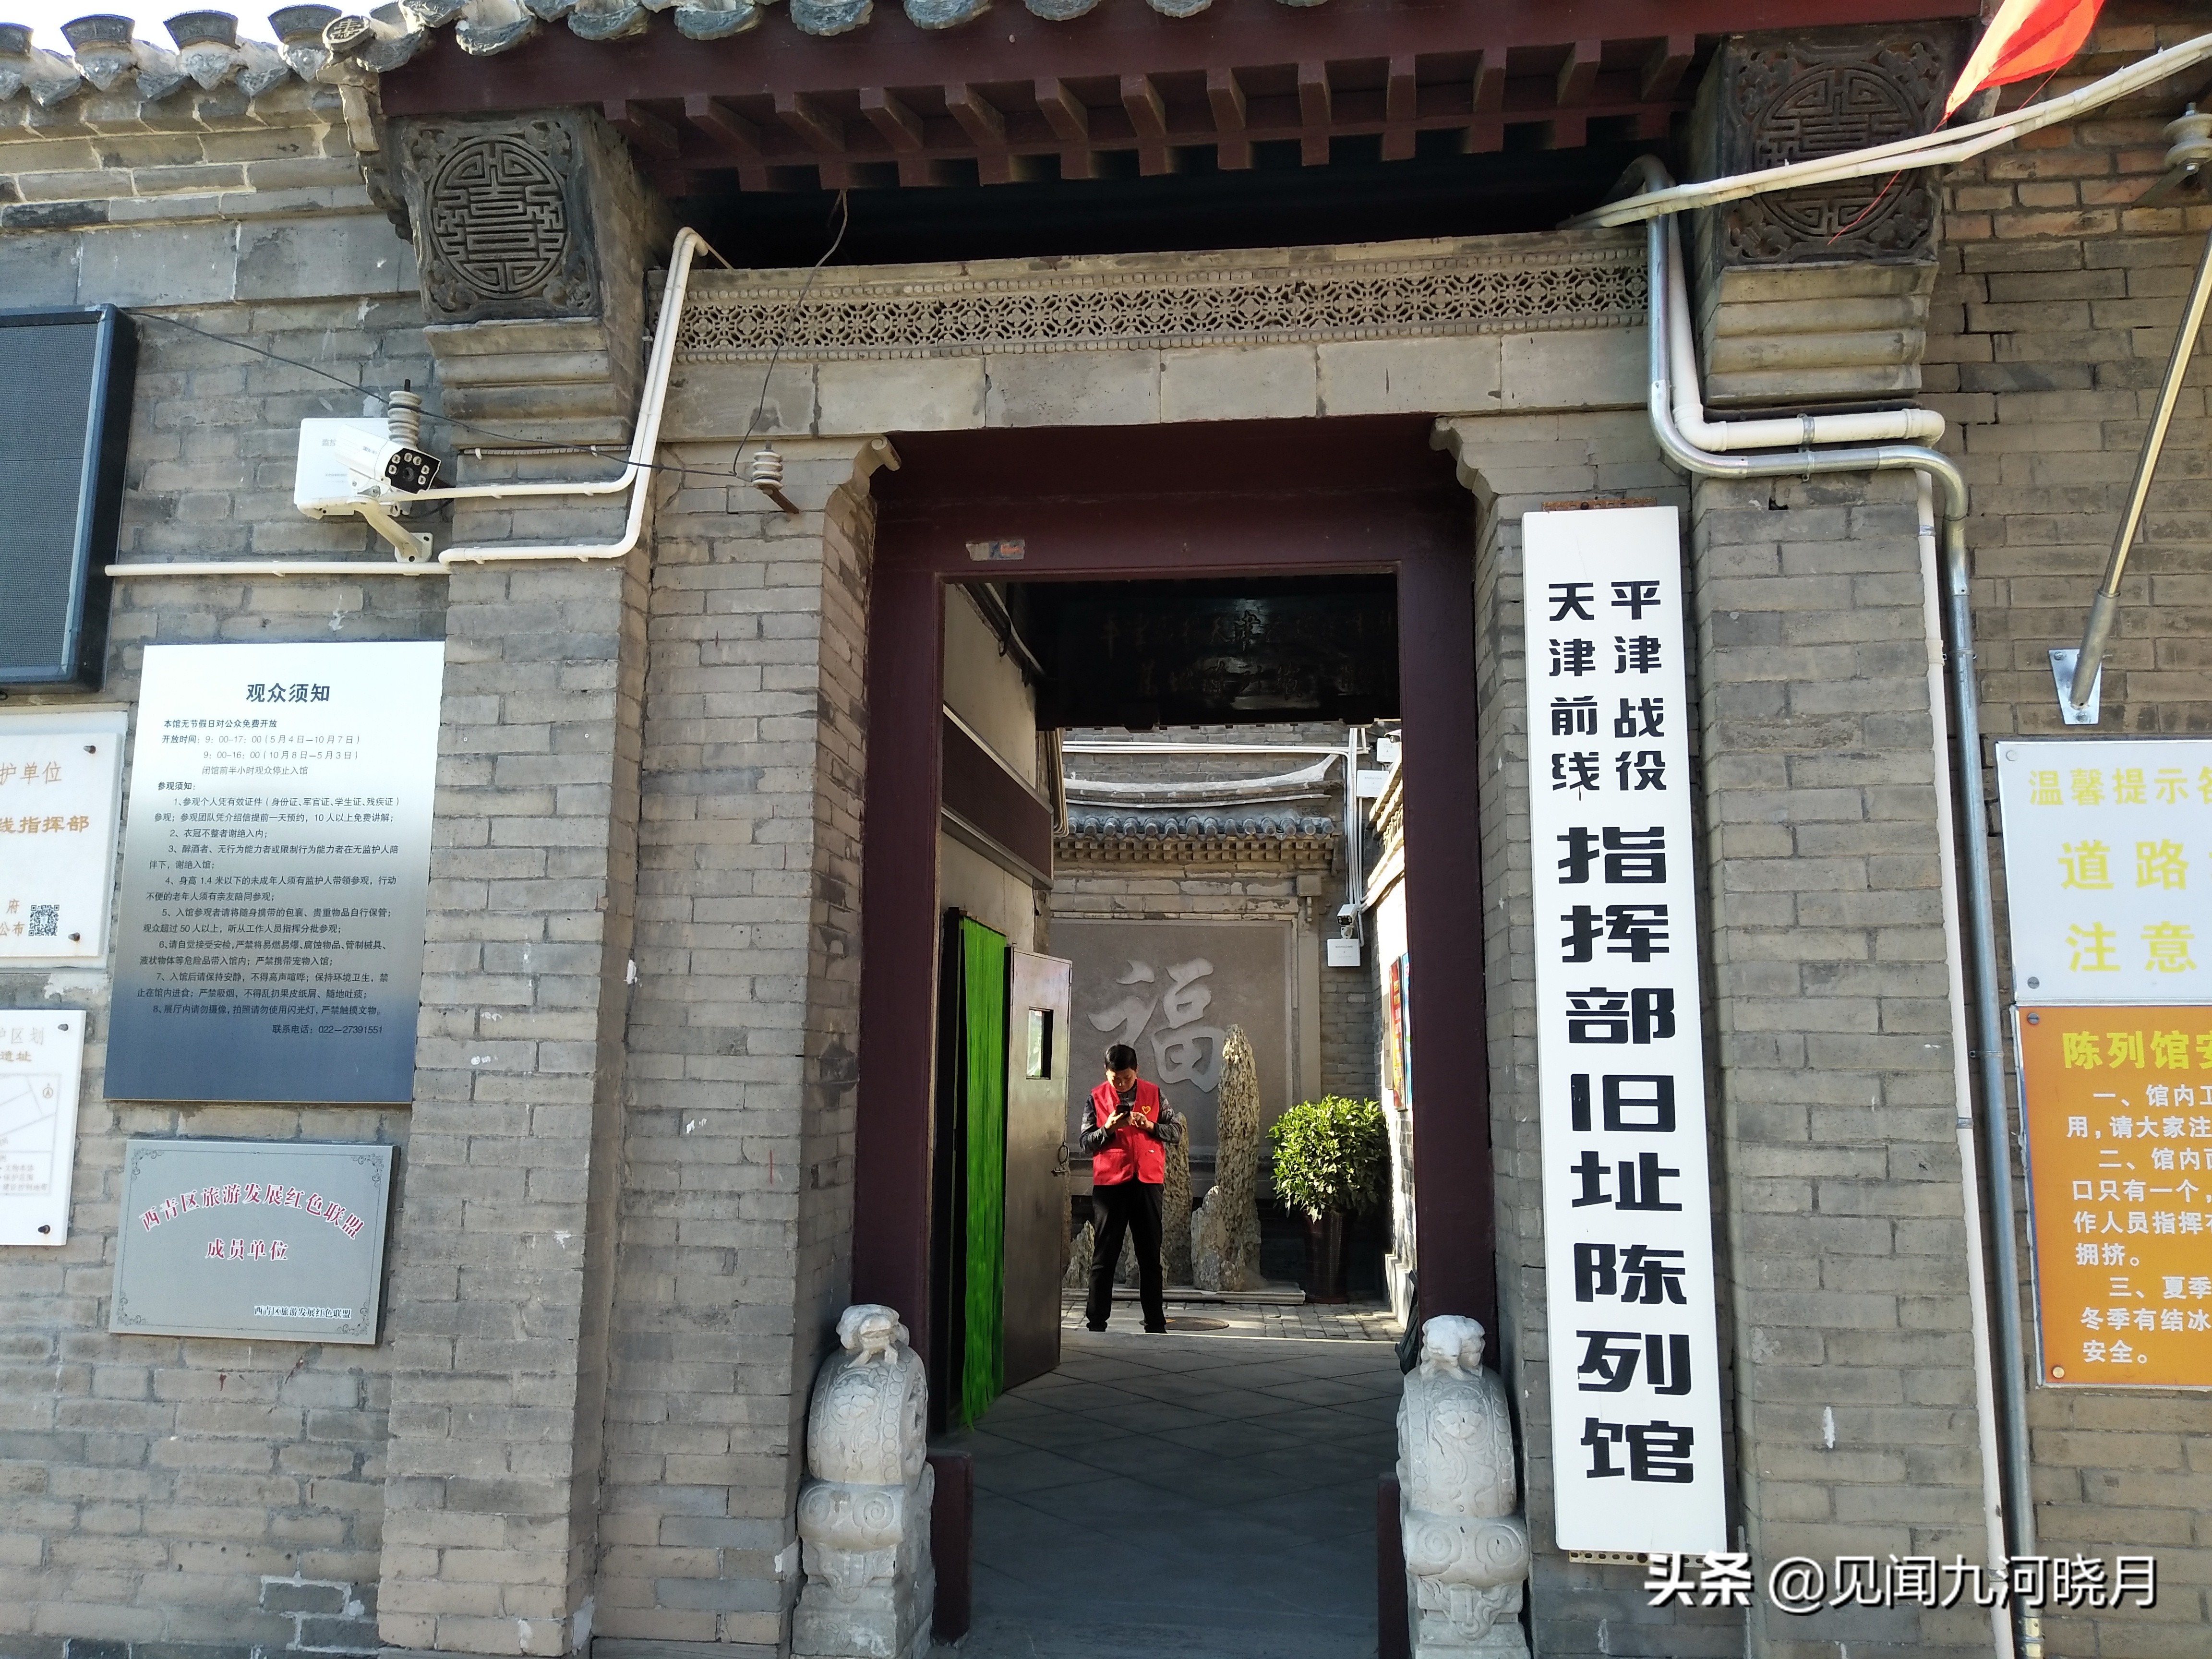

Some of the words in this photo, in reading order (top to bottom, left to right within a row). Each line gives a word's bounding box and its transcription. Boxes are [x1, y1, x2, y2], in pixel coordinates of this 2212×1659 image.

[245, 682, 331, 704] 观众须知
[1548, 581, 1600, 791] 天津前线
[1610, 579, 1667, 792] 平津战役
[163, 718, 278, 729] 本馆无节假日对公众免费开放
[201, 765, 309, 776] 闭馆前半小时观众停止入馆
[168, 843, 399, 855] 3、醉酒者、无行为能力者或限制行为能力者在无监护人陪
[2057, 838, 2212, 891] 道路
[2065, 920, 2198, 974] 注意
[1557, 826, 1695, 1485] 指挥部旧址陈列馆
[139, 1182, 365, 1240] 西青区旅游发展红色联盟
[2072, 1210, 2212, 1236] 作人员指挥
[205, 1238, 289, 1261] 成员单位
[254, 1305, 351, 1320] 西青区旅游发展红色联盟
[2081, 1338, 2148, 1365] 安全。
